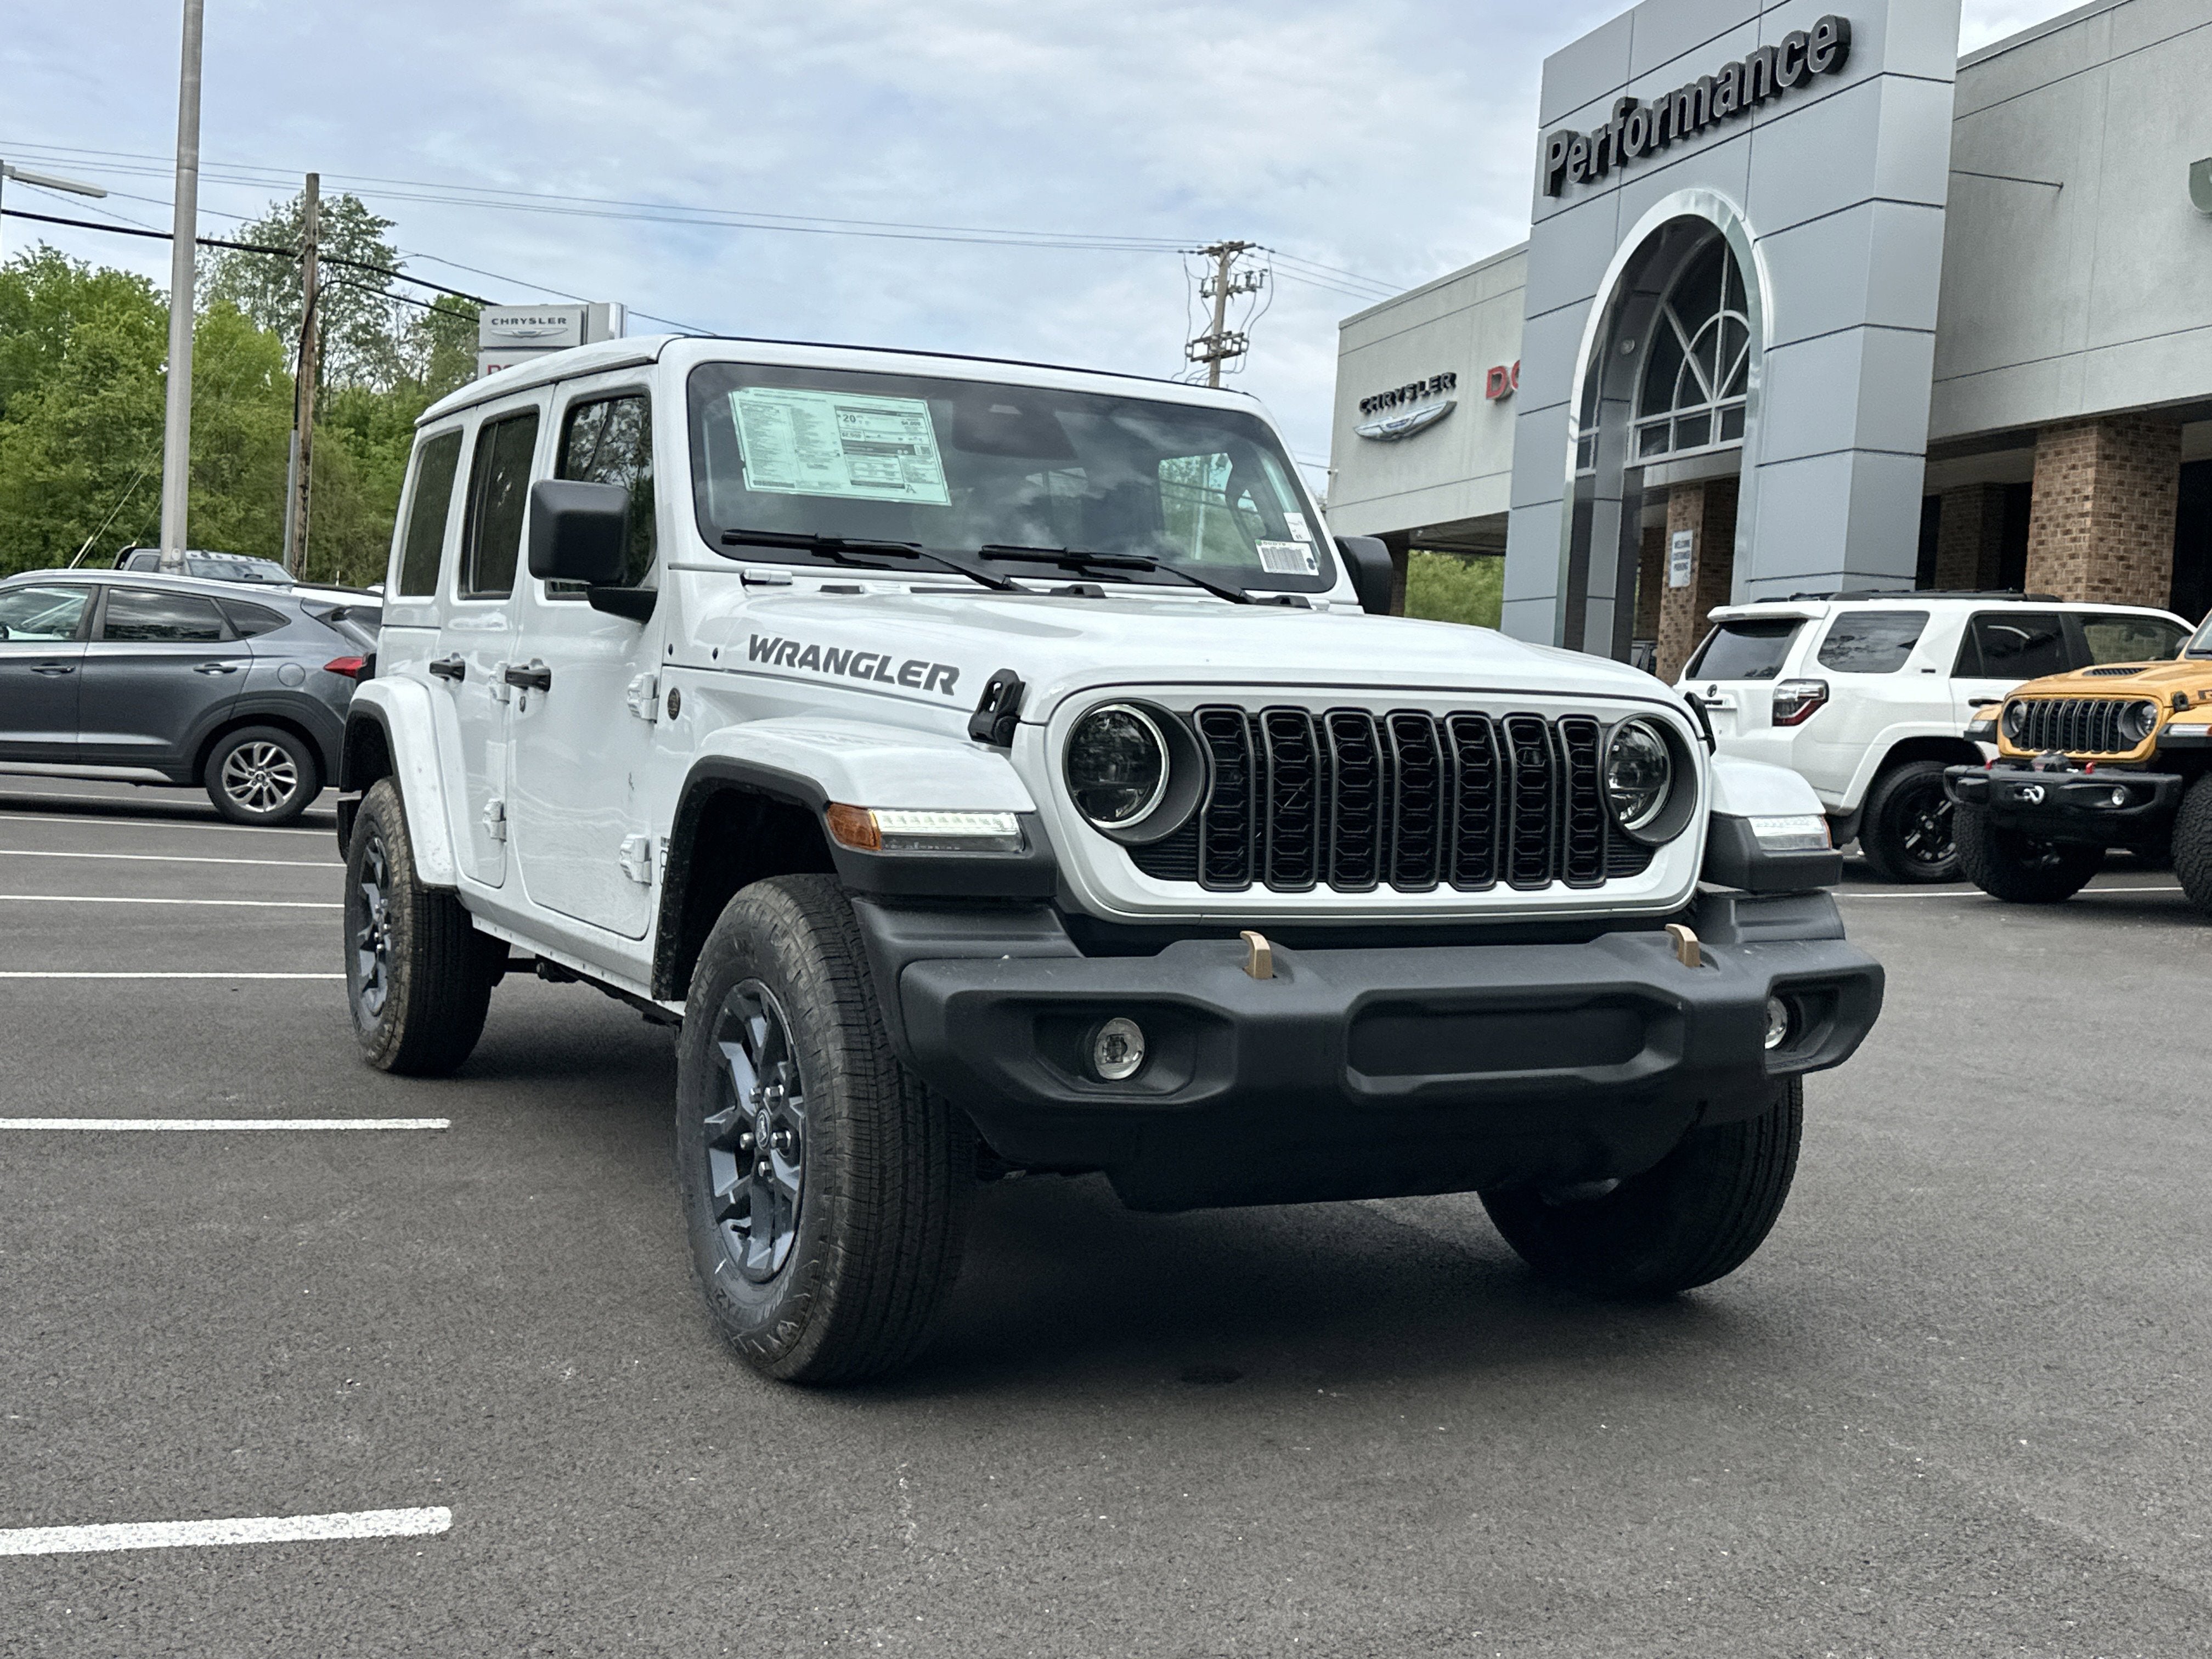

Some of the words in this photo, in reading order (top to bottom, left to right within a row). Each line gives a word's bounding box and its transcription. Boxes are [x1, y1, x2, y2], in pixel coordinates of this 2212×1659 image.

[1543, 14, 1852, 197] Performance
[491, 317, 567, 325] CHRYSLER
[1359, 371, 1457, 414] CHRYSLER
[843, 414, 856, 423] 20
[748, 633, 960, 696] WRANGLER
